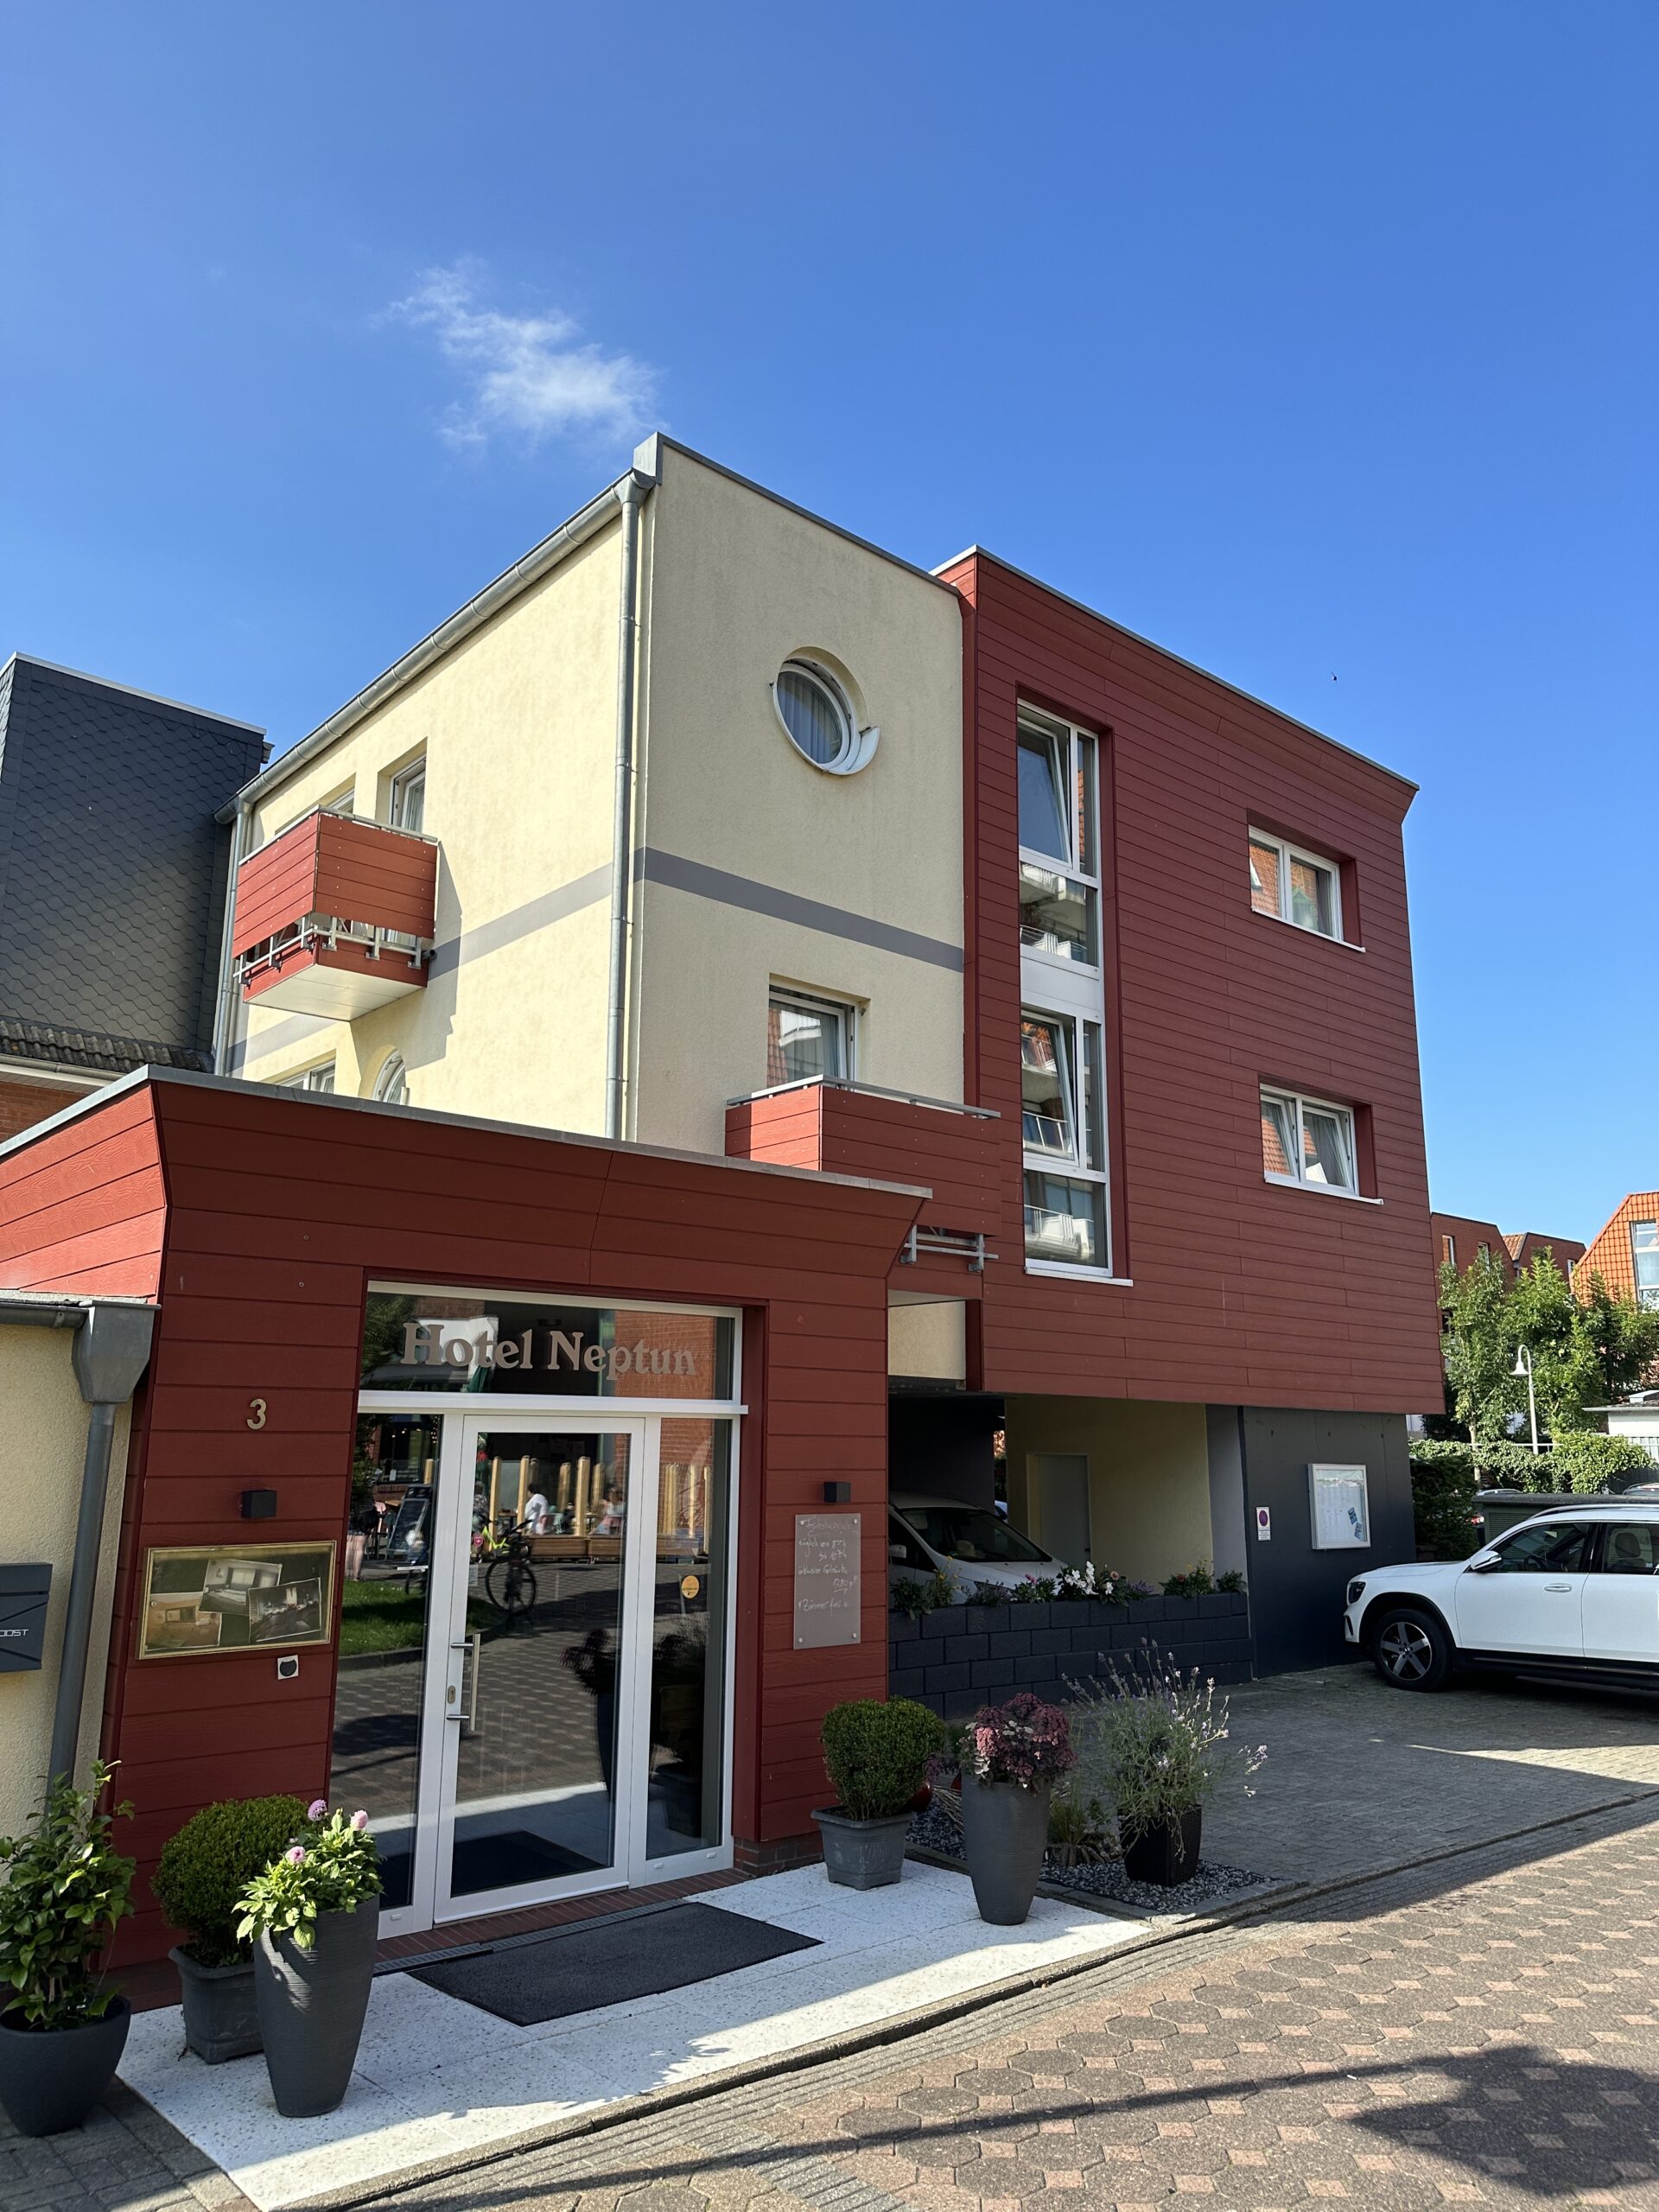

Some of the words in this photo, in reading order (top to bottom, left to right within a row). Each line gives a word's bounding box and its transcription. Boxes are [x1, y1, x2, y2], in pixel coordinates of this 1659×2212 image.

[400, 1322, 533, 1370] Hotel
[547, 1330, 697, 1381] Neptun
[246, 1398, 267, 1430] 3
